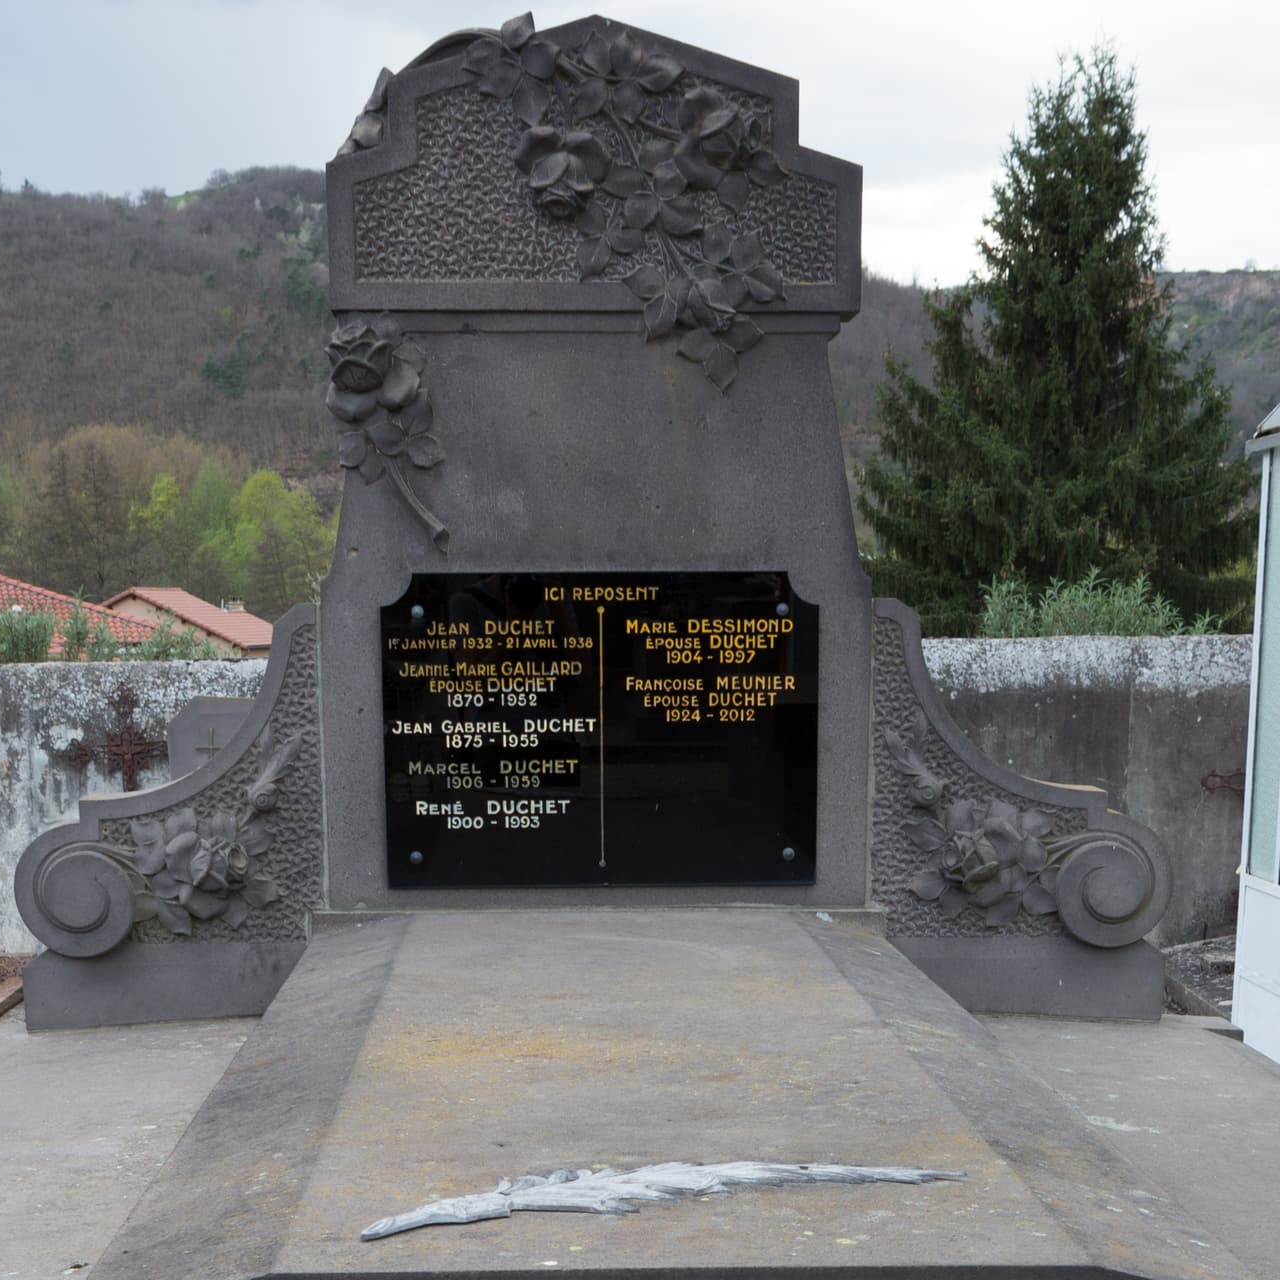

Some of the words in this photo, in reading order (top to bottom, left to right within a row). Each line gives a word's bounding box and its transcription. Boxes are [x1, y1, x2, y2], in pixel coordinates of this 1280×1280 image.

[544, 587, 565, 601] ICI
[572, 586, 660, 601] REPOSENT
[426, 620, 470, 636] JEAN
[484, 620, 556, 636] DUCHET
[625, 619, 678, 634] MARIE
[687, 618, 794, 634] DESSIMOND
[401, 638, 457, 650] JANVIER
[463, 637, 494, 649] 1932
[506, 637, 519, 649] 21
[523, 637, 558, 649] AVRIL
[563, 636, 594, 649] 1938
[645, 635, 702, 650] ÉPOUSE
[709, 634, 778, 649] DUCHET
[666, 650, 703, 664] 1904
[720, 650, 756, 664] 1997
[399, 661, 498, 677] JEANNE-MARIE
[501, 661, 583, 677] GAILLARD
[429, 678, 484, 693] ÉPOUSE
[487, 677, 557, 693] DUCHET
[625, 676, 704, 692] FRANÇOISE
[716, 675, 796, 690] MEUNIER
[447, 693, 484, 708] 1870
[500, 693, 538, 708] 1952
[643, 692, 700, 707] ÉPOUSE
[708, 692, 778, 707] DUCHET
[665, 708, 702, 722] 1924
[719, 708, 756, 722] 2012
[391, 720, 433, 735] JEAN
[441, 719, 511, 734] GABRIEL
[523, 718, 597, 733] DUCHET
[445, 734, 484, 748] 1875
[502, 734, 540, 748] 1955
[408, 761, 482, 776] MARCEL
[499, 759, 579, 775] DUCHET
[446, 776, 484, 789] 1906
[504, 775, 541, 788] 1959
[415, 800, 465, 816] RENÉ
[486, 799, 571, 815] DUCHET
[447, 816, 484, 829] 1900
[504, 815, 541, 829] 1993
